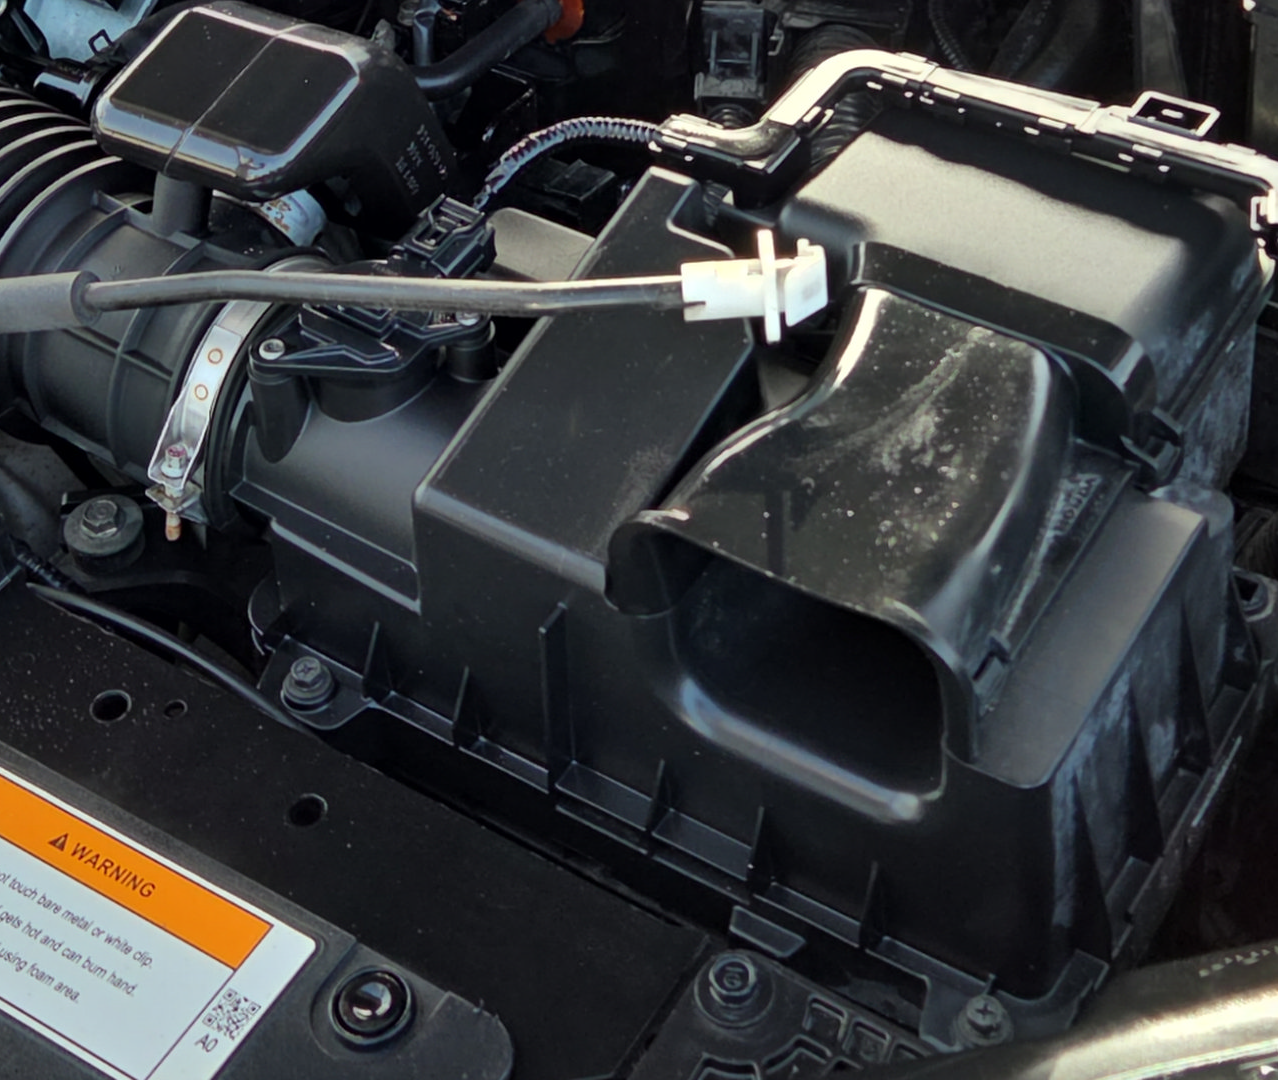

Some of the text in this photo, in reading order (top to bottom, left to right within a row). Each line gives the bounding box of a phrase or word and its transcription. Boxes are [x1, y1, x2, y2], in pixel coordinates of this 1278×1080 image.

[71, 842, 156, 898] WARNING
[8, 877, 38, 900] touch
[37, 893, 62, 914] bare
[62, 909, 94, 932] metal
[90, 925, 105, 939] or
[104, 932, 133, 956] white
[132, 951, 153, 969] clip.
[21, 921, 42, 940] hot
[39, 934, 65, 952] and
[61, 947, 83, 964] can
[26, 962, 55, 987] foam
[194, 1033, 219, 1053] A0
